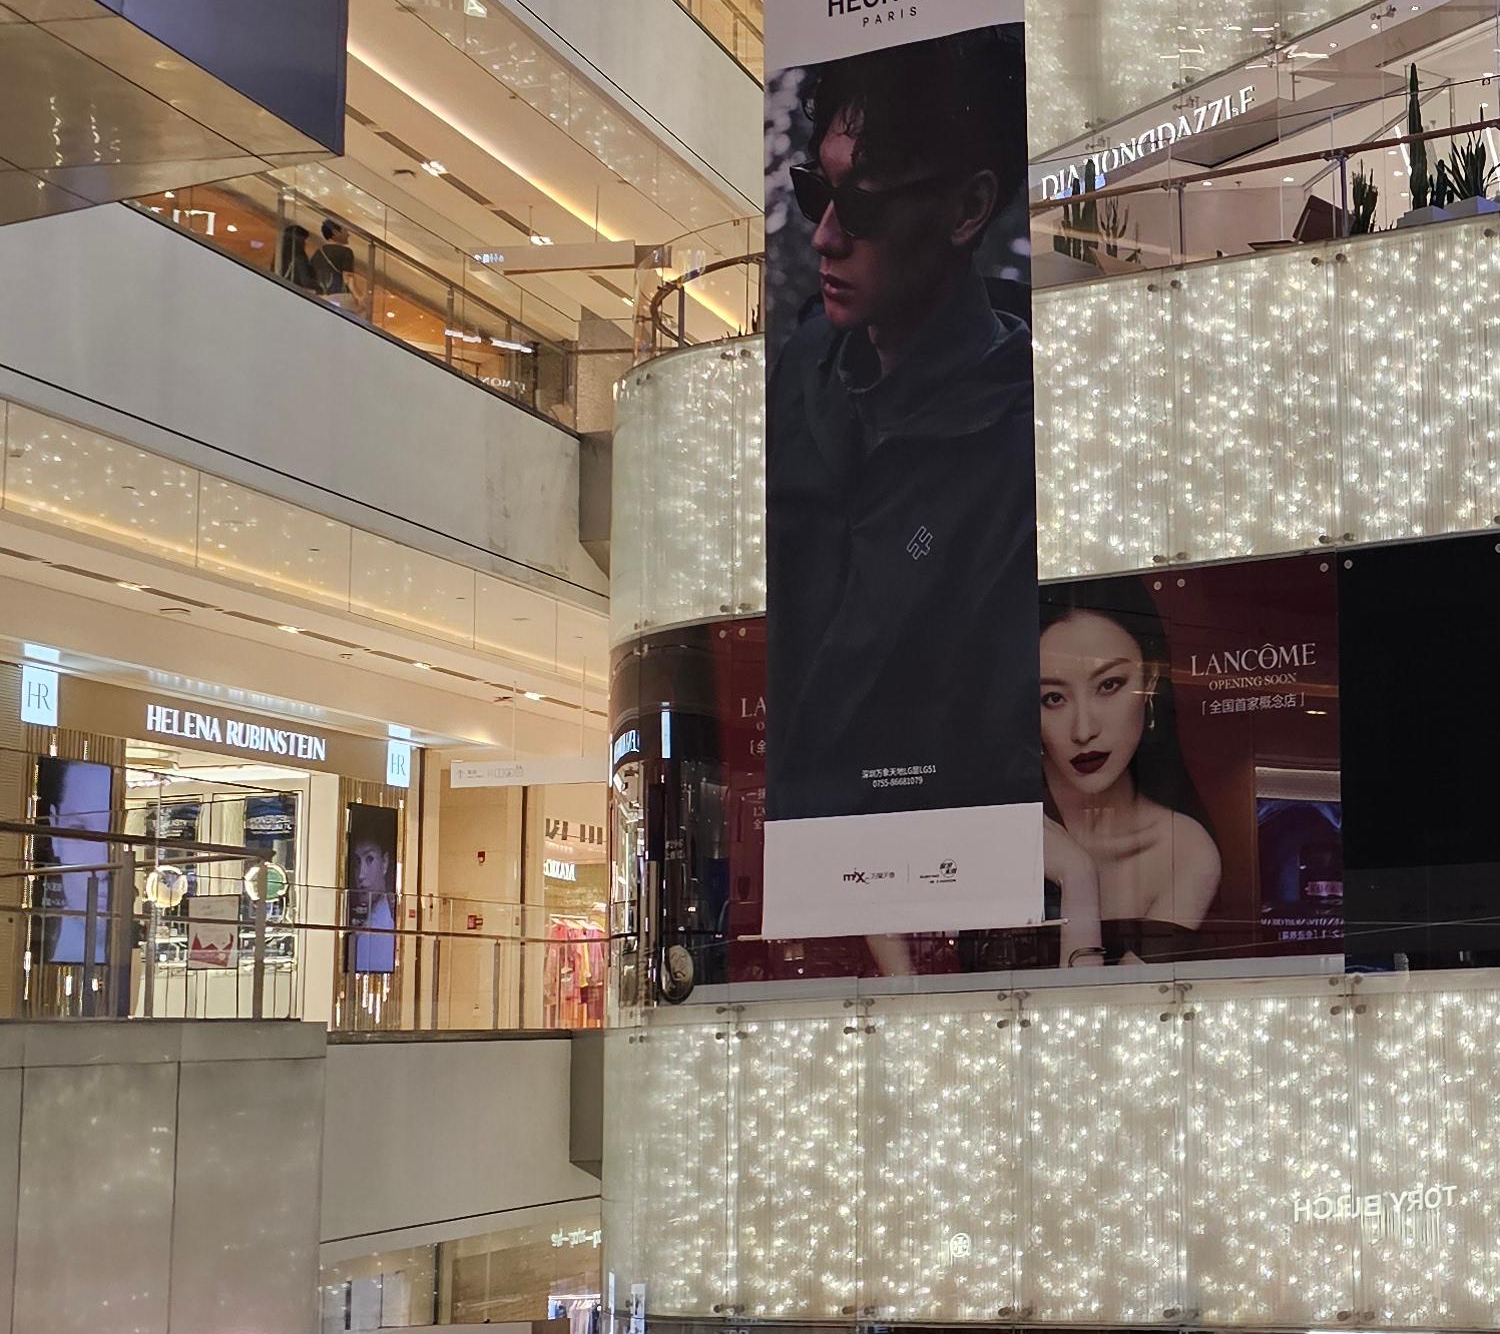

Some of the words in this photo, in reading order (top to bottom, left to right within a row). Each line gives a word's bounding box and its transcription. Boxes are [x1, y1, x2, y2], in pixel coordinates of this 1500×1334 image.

[863, 6, 918, 27] PARIS
[1191, 643, 1317, 677] LANCÔME
[1209, 676, 1263, 692] OPENING
[1264, 672, 1297, 687] SOON
[27, 681, 51, 710] HR
[146, 704, 222, 743] HELENA
[226, 720, 326, 761] RUBINSTEIN
[391, 753, 406, 777] HR
